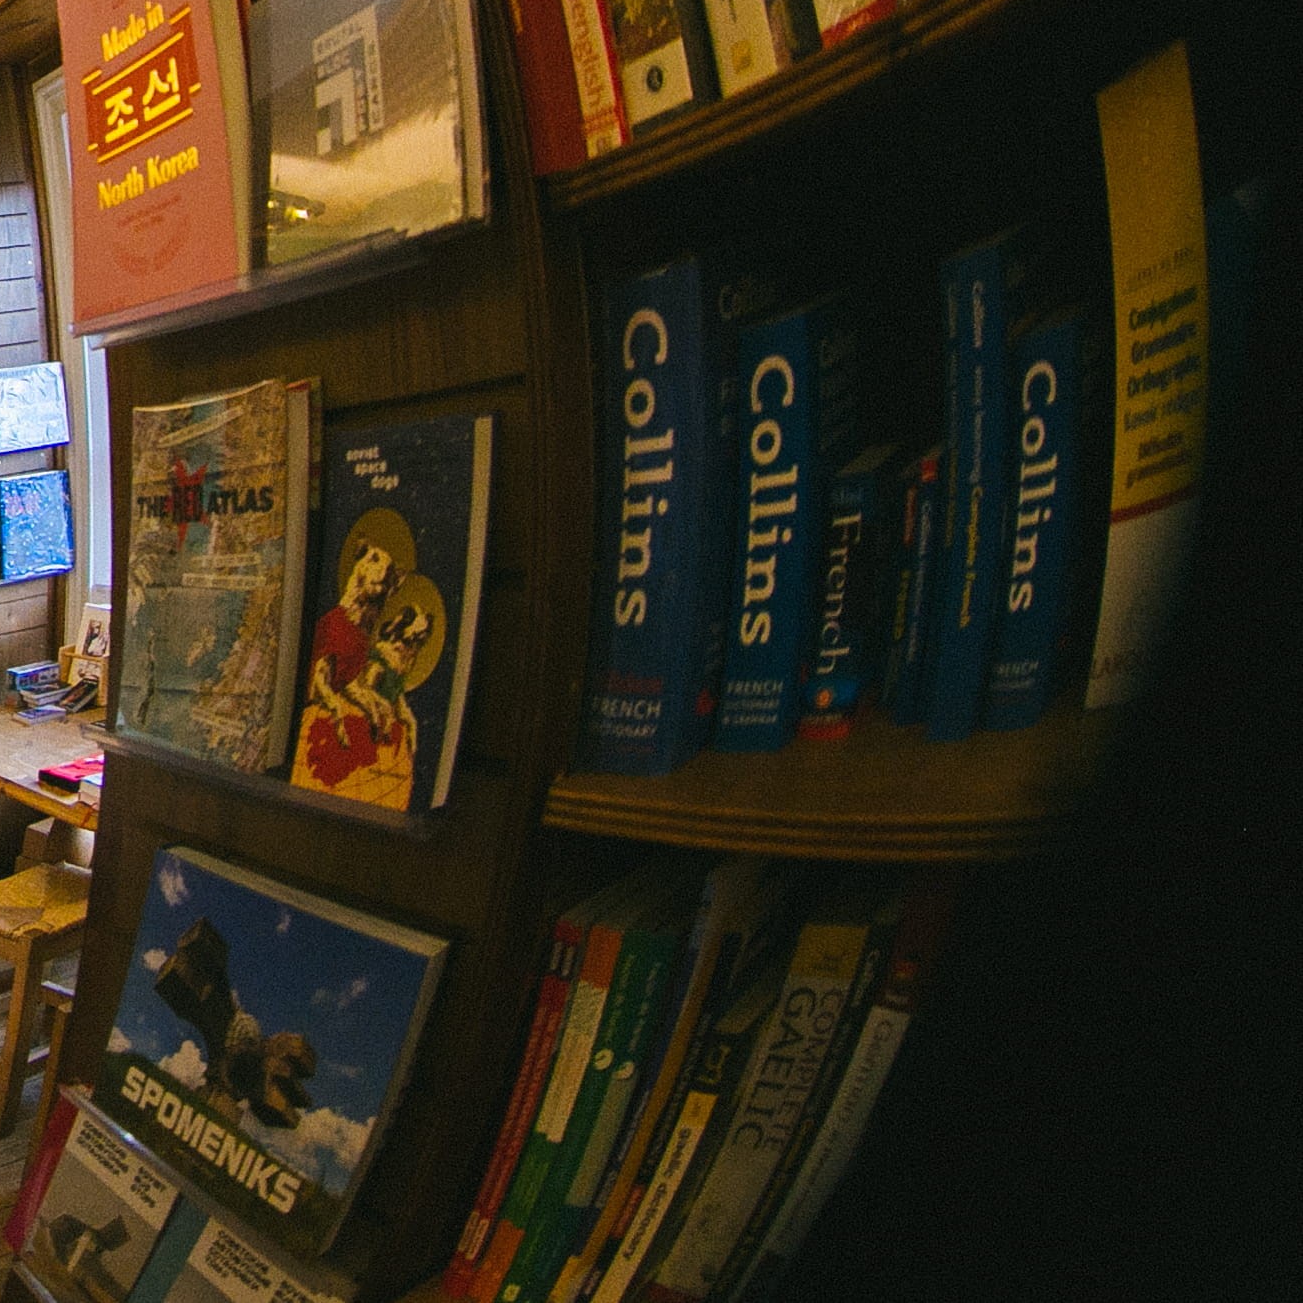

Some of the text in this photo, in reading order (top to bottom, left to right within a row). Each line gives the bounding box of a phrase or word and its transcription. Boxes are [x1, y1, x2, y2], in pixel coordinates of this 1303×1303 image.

[101, 1, 165, 63] Made in
[104, 57, 181, 145] 조선
[98, 146, 200, 210] North Korea
[206, 486, 274, 514] ATLAS
[614, 307, 676, 628] Collins
[739, 354, 799, 648] Collins
[1008, 358, 1059, 615] Collins
[815, 511, 863, 676] French
[122, 1066, 302, 1214] SPOMENIKS
[730, 985, 817, 1152] GAELIC
